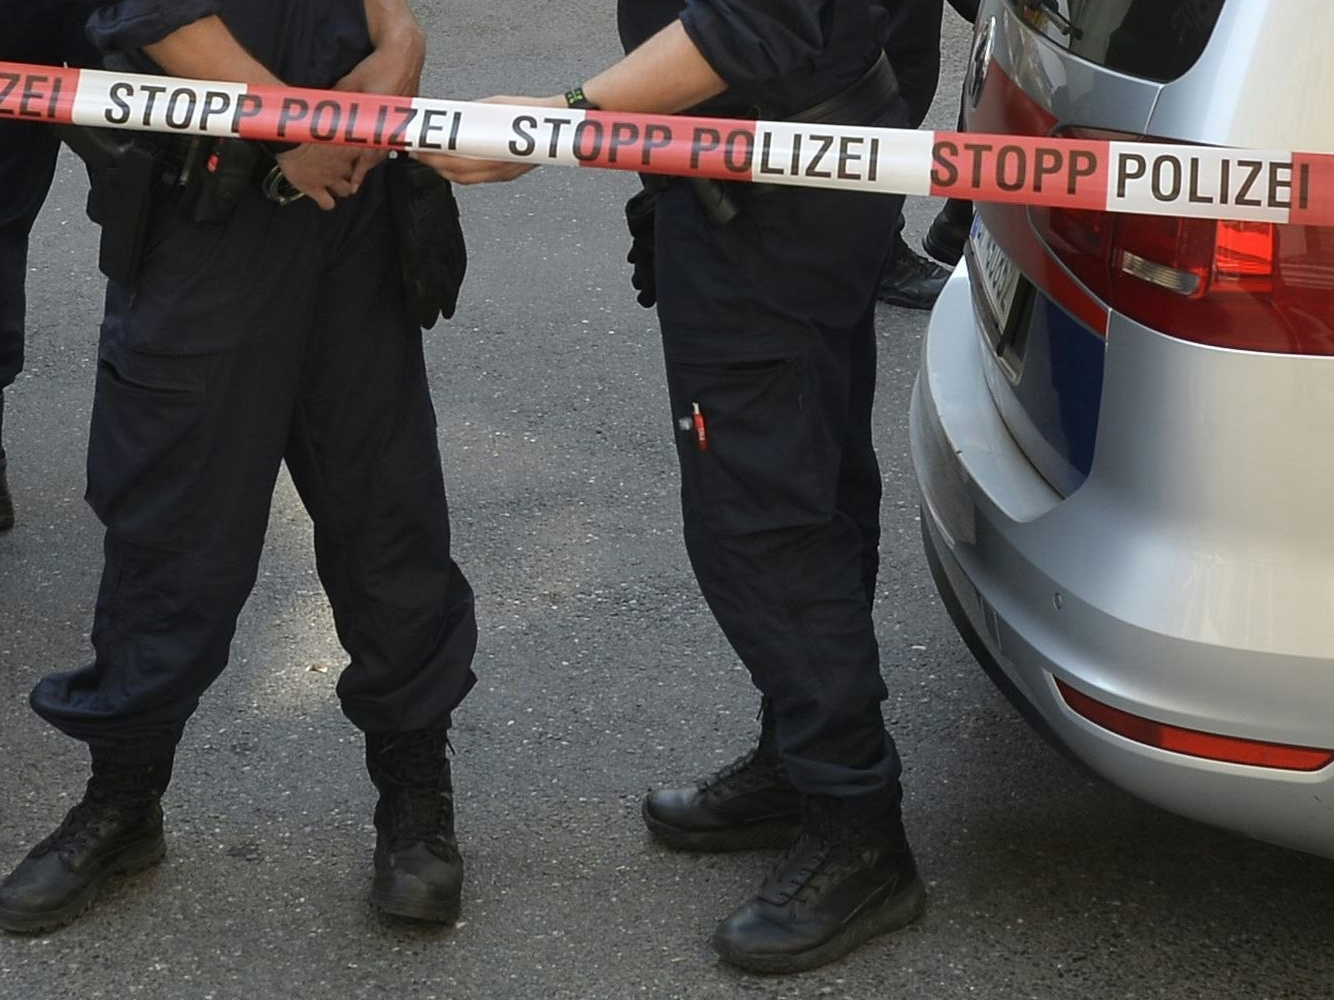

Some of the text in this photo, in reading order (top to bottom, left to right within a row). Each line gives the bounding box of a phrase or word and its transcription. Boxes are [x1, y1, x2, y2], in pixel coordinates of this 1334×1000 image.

[104, 82, 263, 133] STOPP
[278, 97, 462, 151] POLIZEI
[508, 115, 672, 166] STOPP
[689, 127, 880, 182] POLIZEI
[930, 140, 1098, 196] STOPP
[1116, 152, 1310, 210] POLIZEI
